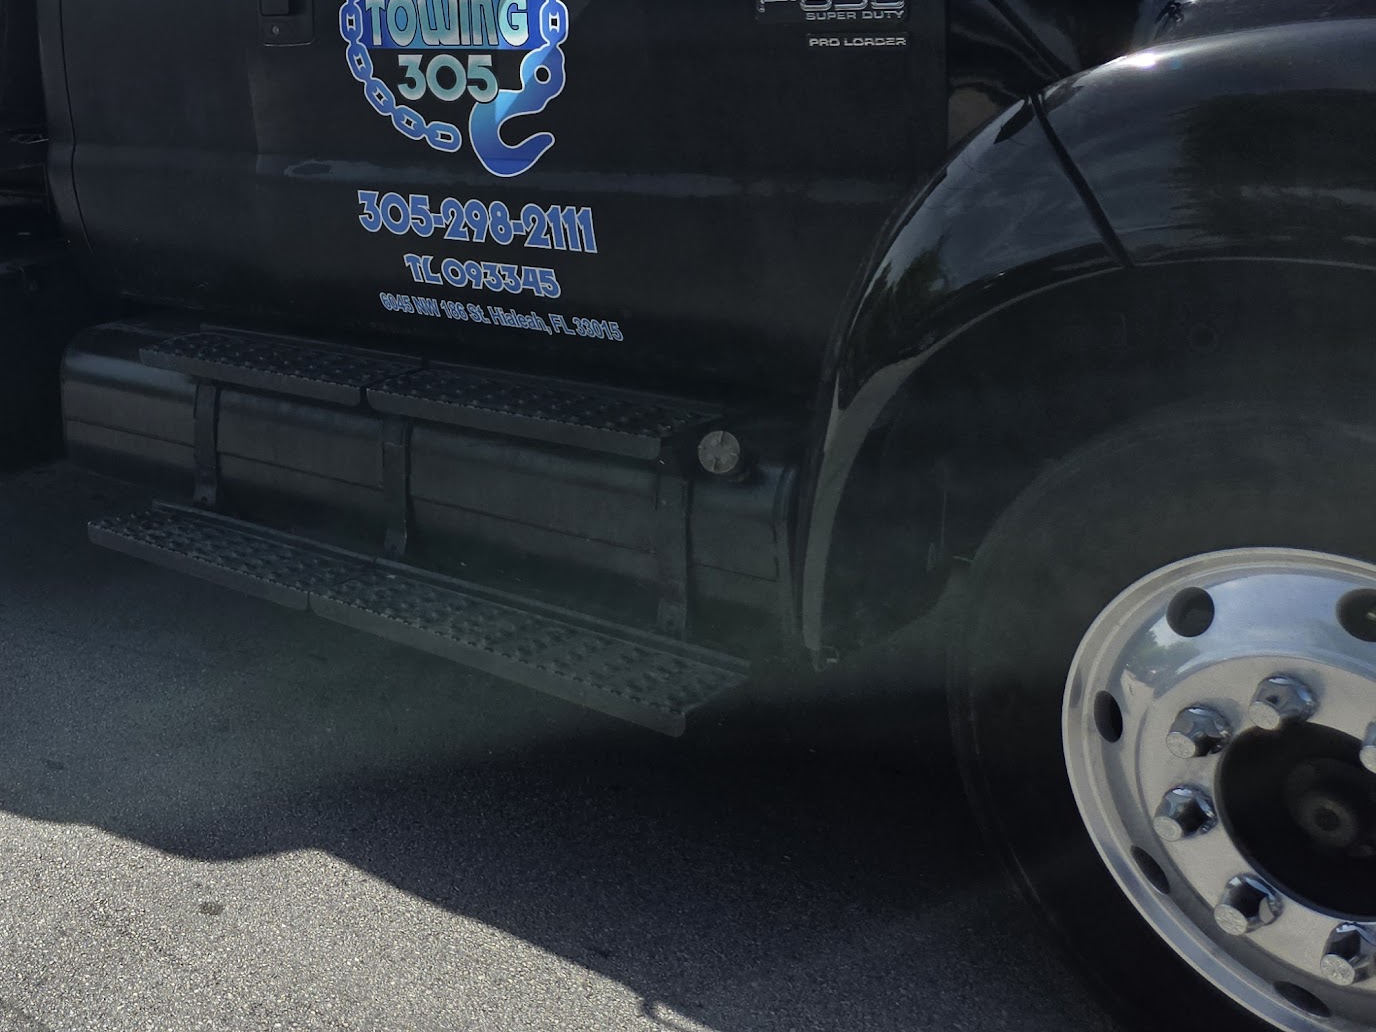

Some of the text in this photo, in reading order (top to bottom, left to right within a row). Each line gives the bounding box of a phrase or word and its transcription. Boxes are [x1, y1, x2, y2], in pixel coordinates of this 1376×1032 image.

[805, 10, 904, 20] SUPER DUTY
[809, 37, 907, 46] PRO LOADER
[397, 54, 499, 102] 305
[357, 189, 598, 254] 305-298-2111
[403, 253, 561, 298] TL 093345
[379, 292, 624, 341] 6045 NW 186 St. Hialeah, FL 33015
